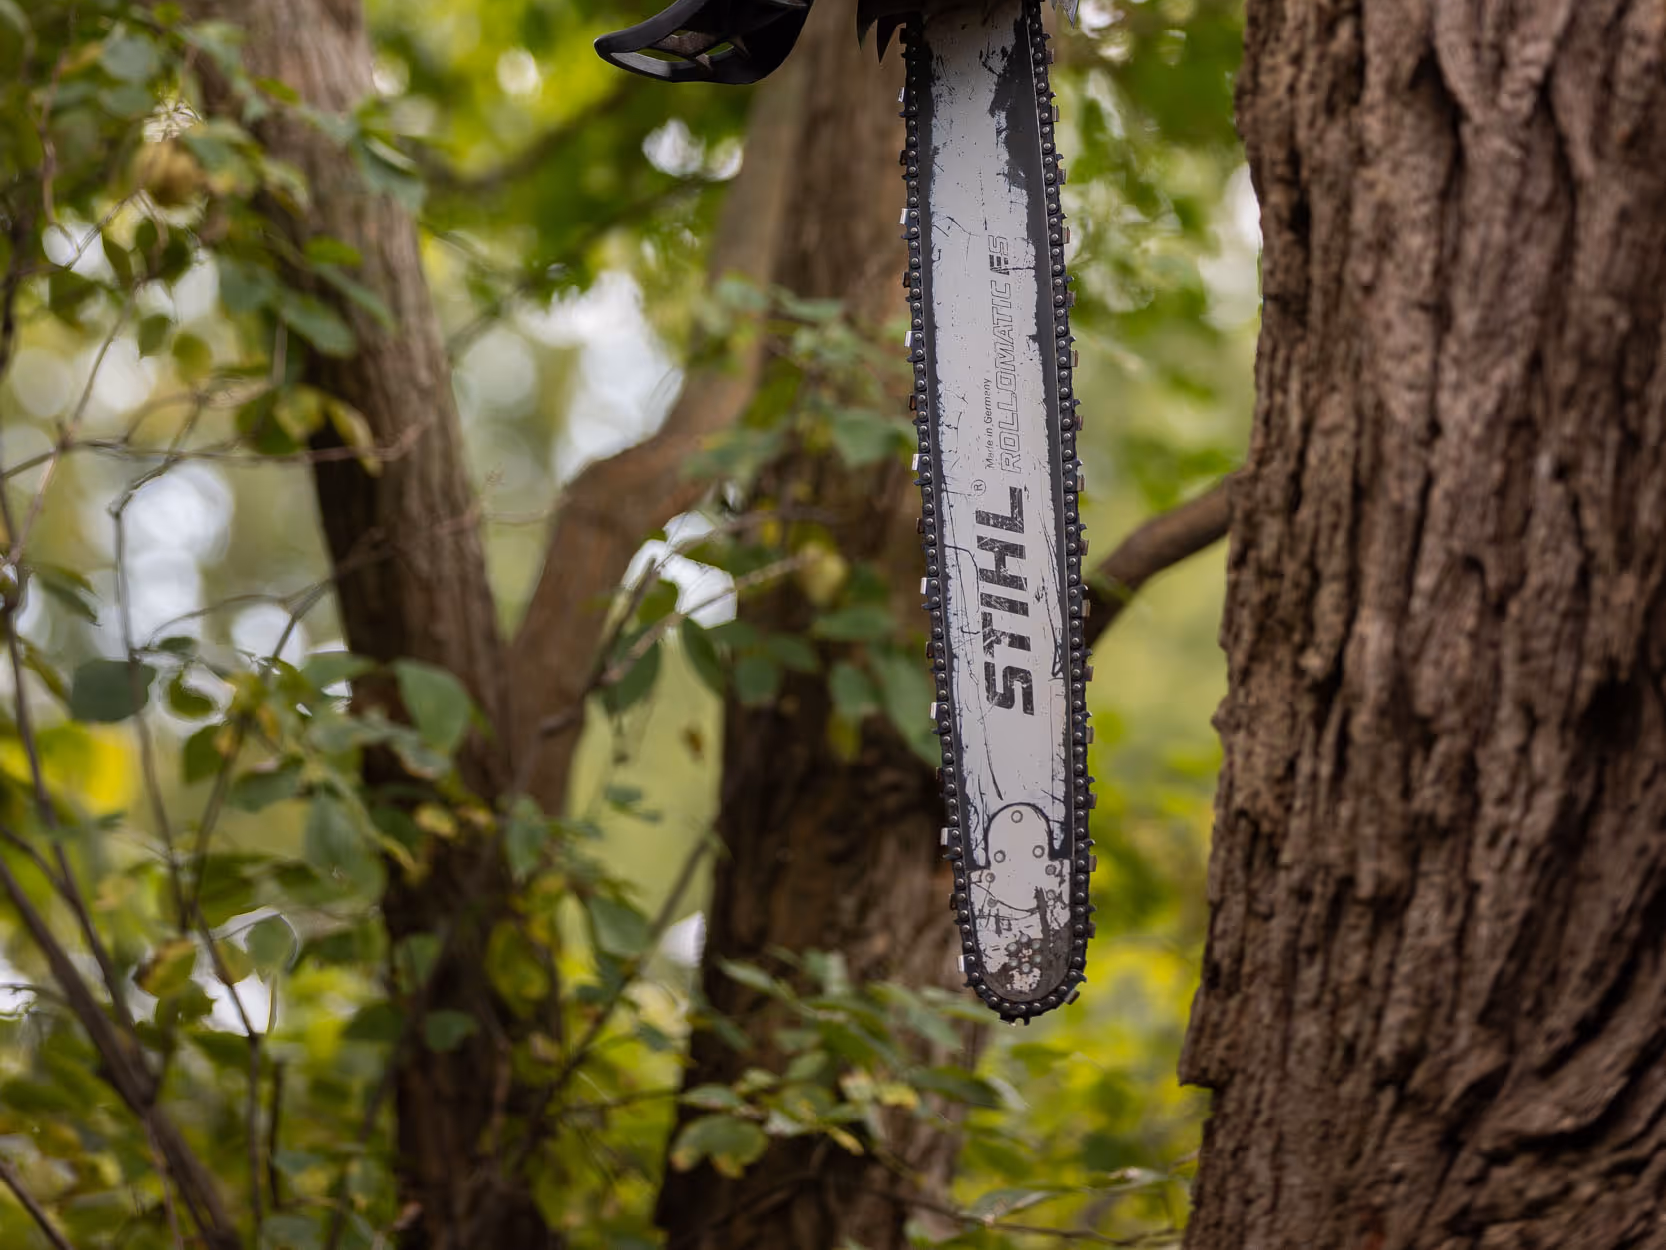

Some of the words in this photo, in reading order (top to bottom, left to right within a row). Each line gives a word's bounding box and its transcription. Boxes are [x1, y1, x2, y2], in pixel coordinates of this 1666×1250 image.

[990, 279, 1022, 474] ROLLOMATIC
[982, 378, 994, 424] Germany
[984, 427, 993, 438] in
[984, 440, 995, 470] Made
[975, 486, 1034, 716] STIHL
